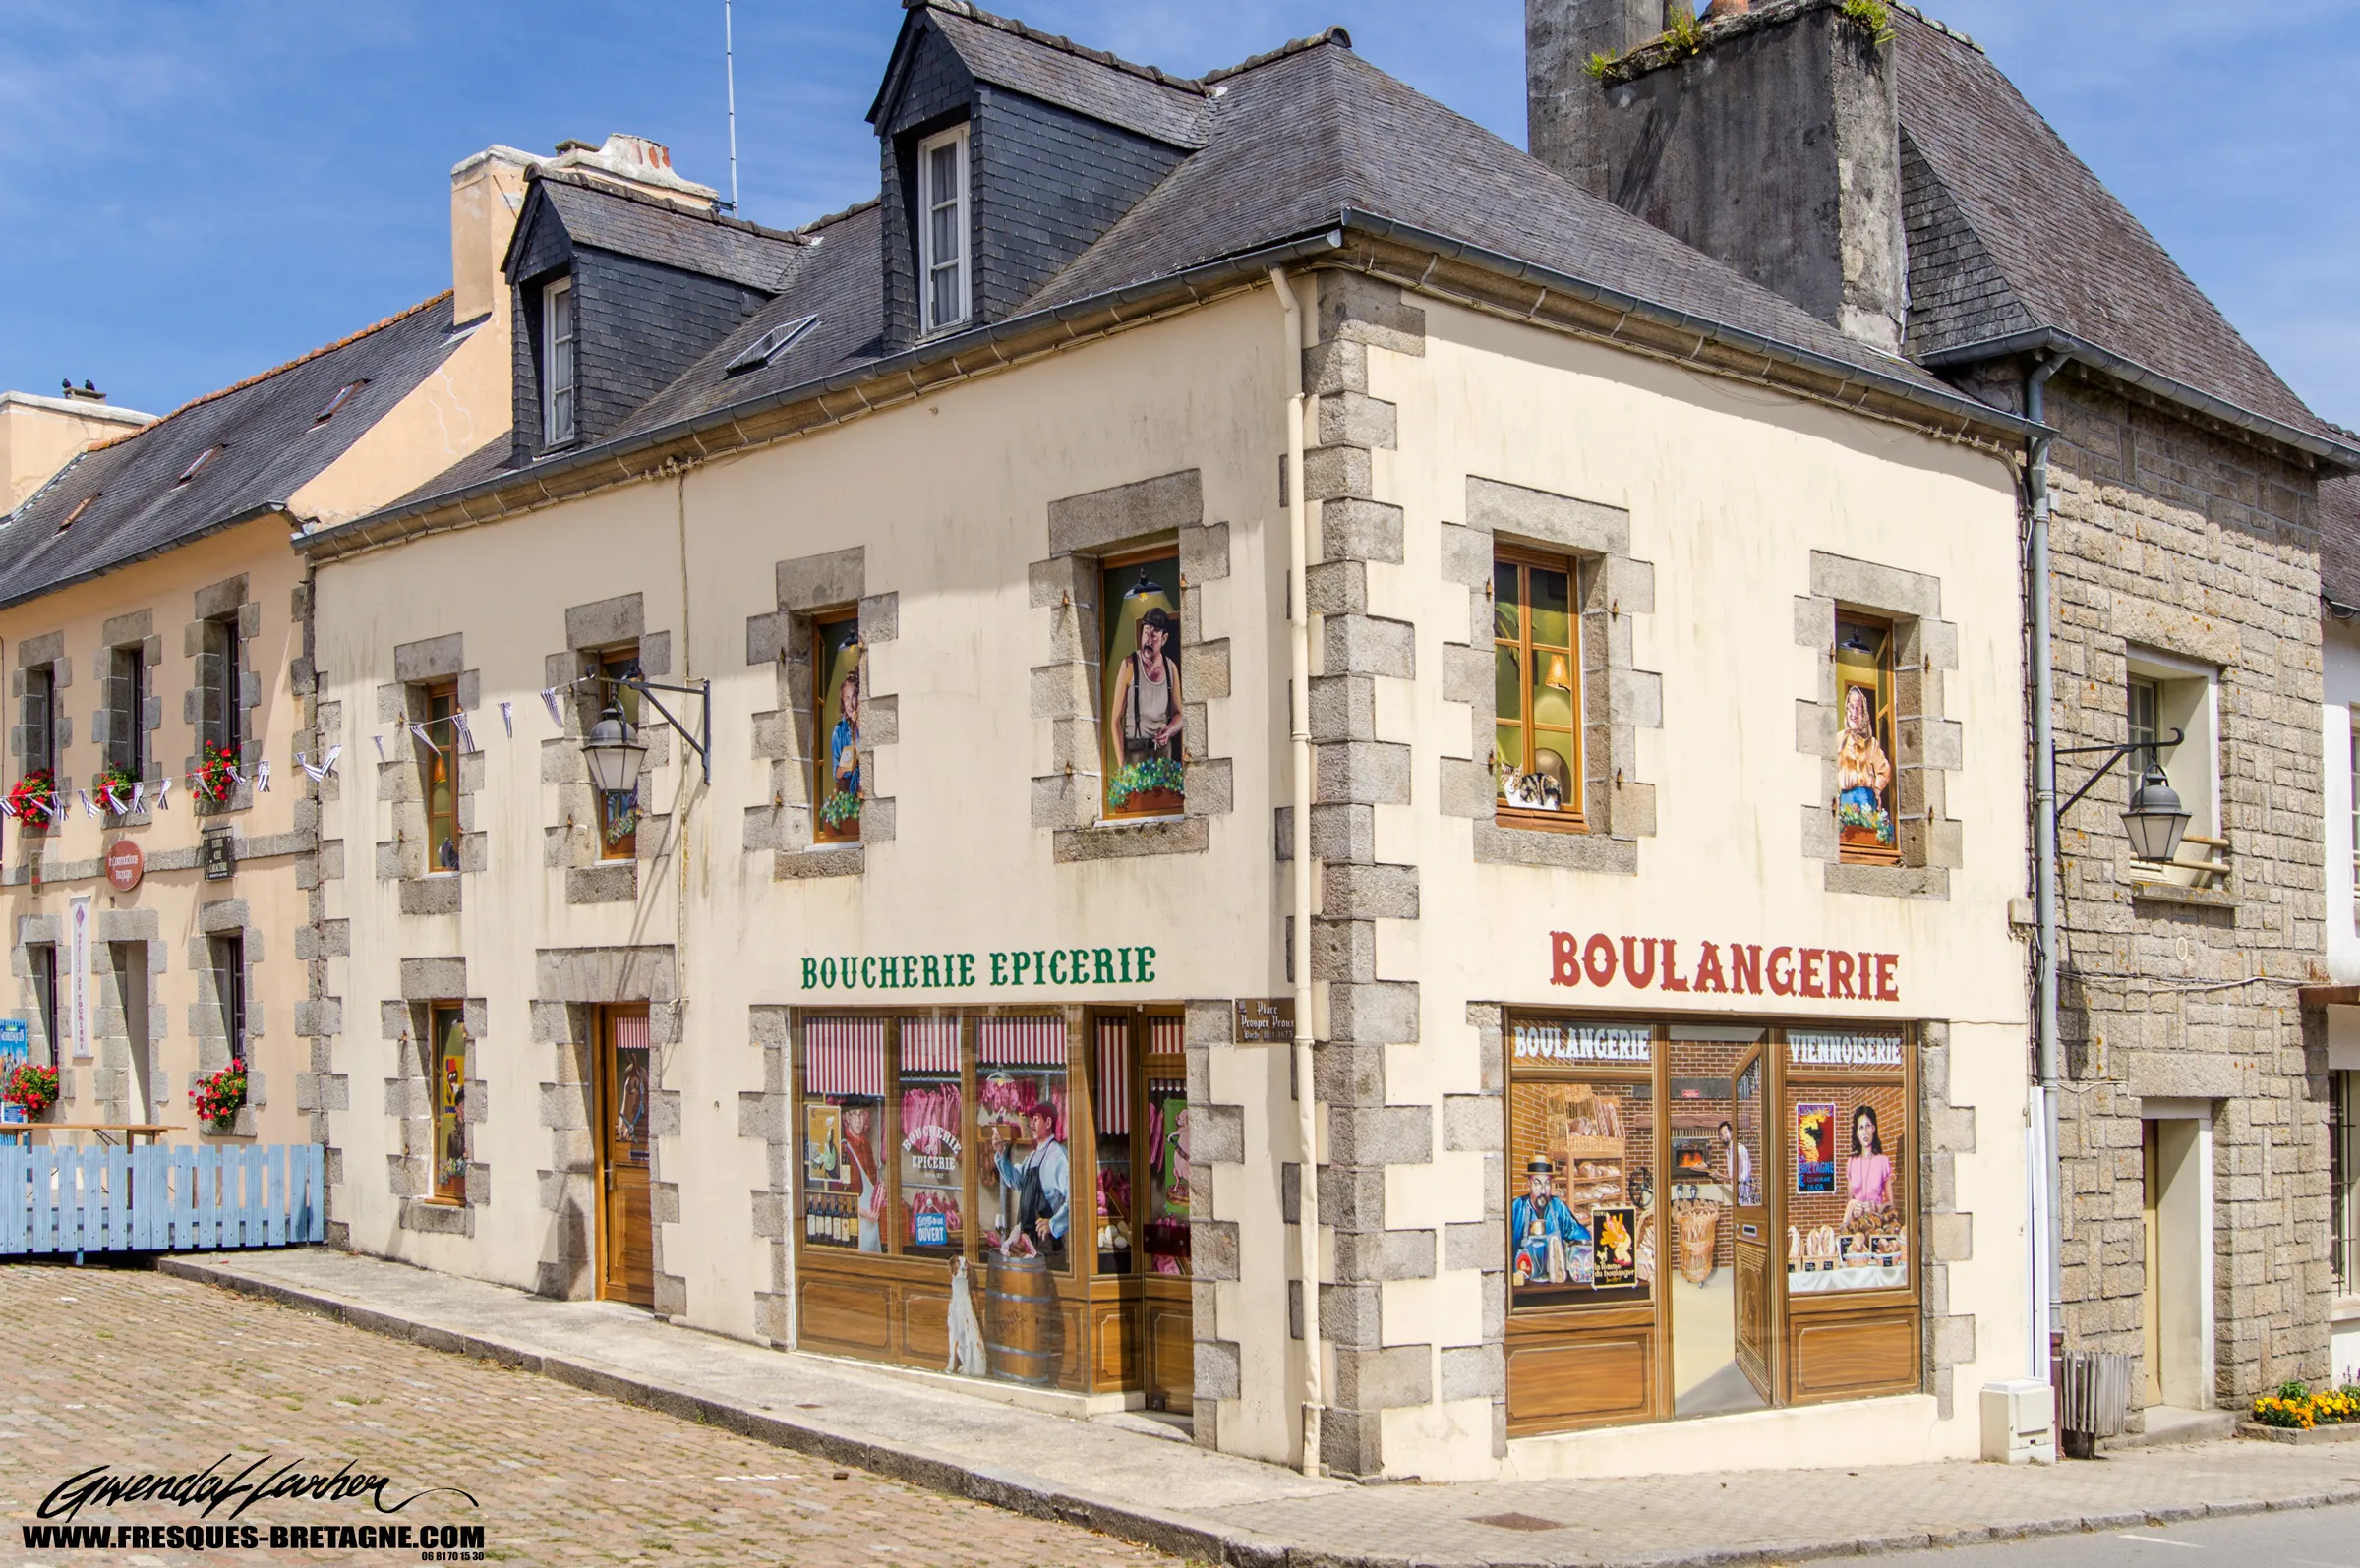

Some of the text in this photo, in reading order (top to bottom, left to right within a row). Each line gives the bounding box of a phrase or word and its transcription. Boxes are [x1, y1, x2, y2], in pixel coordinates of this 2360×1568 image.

[801, 946, 1156, 989] BOUCHERIE EPICERIE
[1549, 930, 1900, 1001] BOULANGERIE
[1257, 1001, 1277, 1015] Place
[1241, 1015, 1294, 1030] Prosper Proux
[1514, 1026, 1651, 1061] BOULANGERIE
[1787, 1034, 1901, 1065] VIENNOISERIE
[902, 1125, 962, 1155] BOUCHERIE
[913, 1155, 955, 1170] EPICERIE
[1799, 1161, 1834, 1174] BRETAGNE
[918, 1227, 944, 1241] OUVERT
[1604, 1269, 1635, 1278] boulanger
